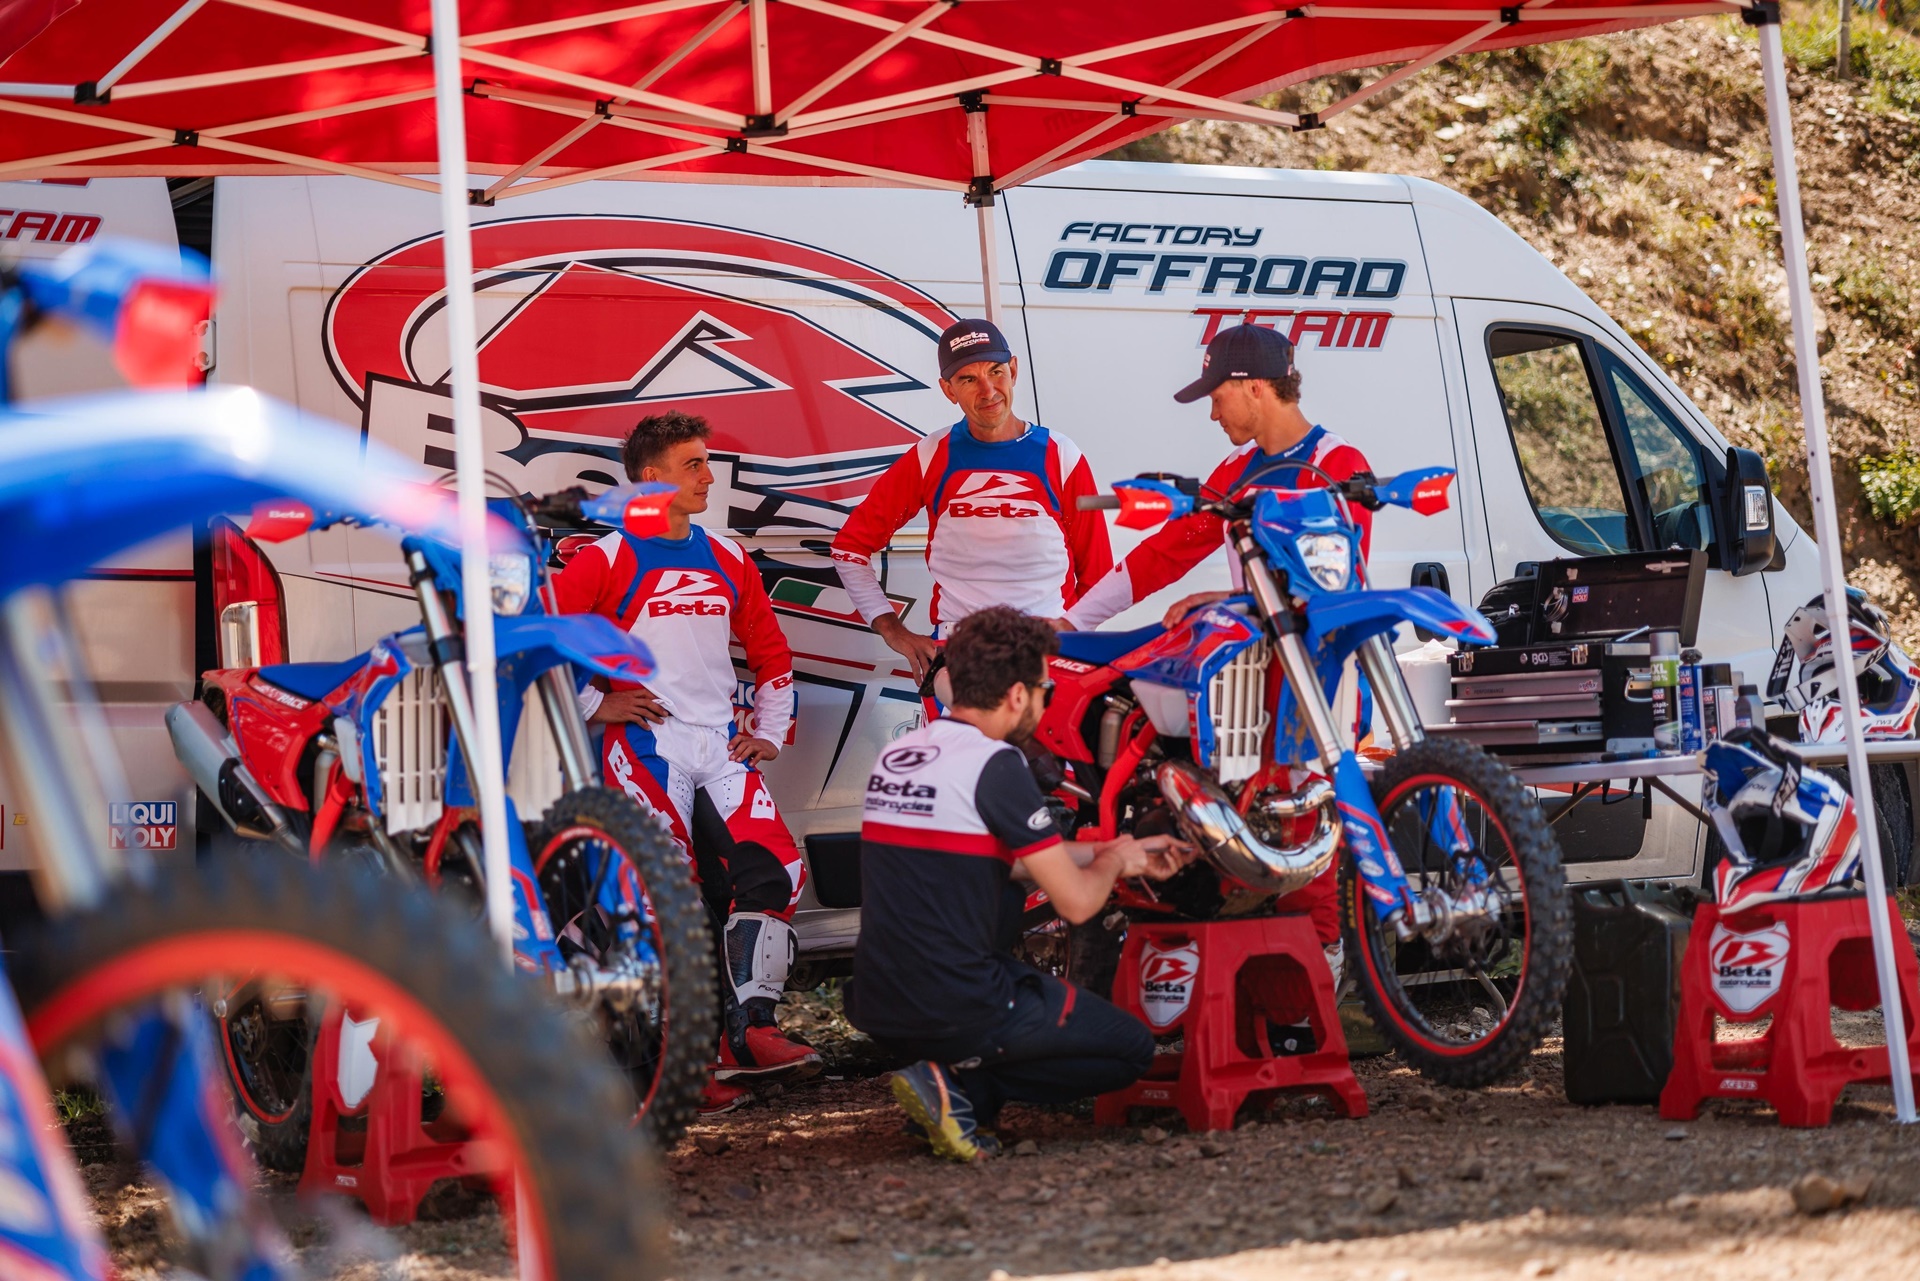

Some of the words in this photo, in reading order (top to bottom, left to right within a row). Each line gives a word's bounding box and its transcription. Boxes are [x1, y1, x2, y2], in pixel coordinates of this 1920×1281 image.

[0, 209, 102, 243] AM
[1059, 221, 1263, 246] FACTORY
[1042, 250, 1407, 299] OFFROAD
[950, 331, 989, 348] Beta
[1417, 489, 1442, 498] Beta
[629, 507, 660, 516] Beta
[949, 502, 1040, 518] Beta
[1135, 501, 1166, 510] Beta
[268, 510, 306, 519] Beta
[647, 600, 727, 618] Beta
[1050, 658, 1091, 673] RACE
[1473, 687, 1505, 695] PERFORMANCE
[277, 690, 309, 710] RACE
[866, 774, 937, 799] Beta
[112, 803, 173, 825] LIQUI
[112, 827, 174, 847] MOLY
[1720, 965, 1772, 977] Beta
[1145, 981, 1185, 993] Beta
[1720, 979, 1771, 988] motorcycles
[1144, 994, 1185, 1003] motorcycles
